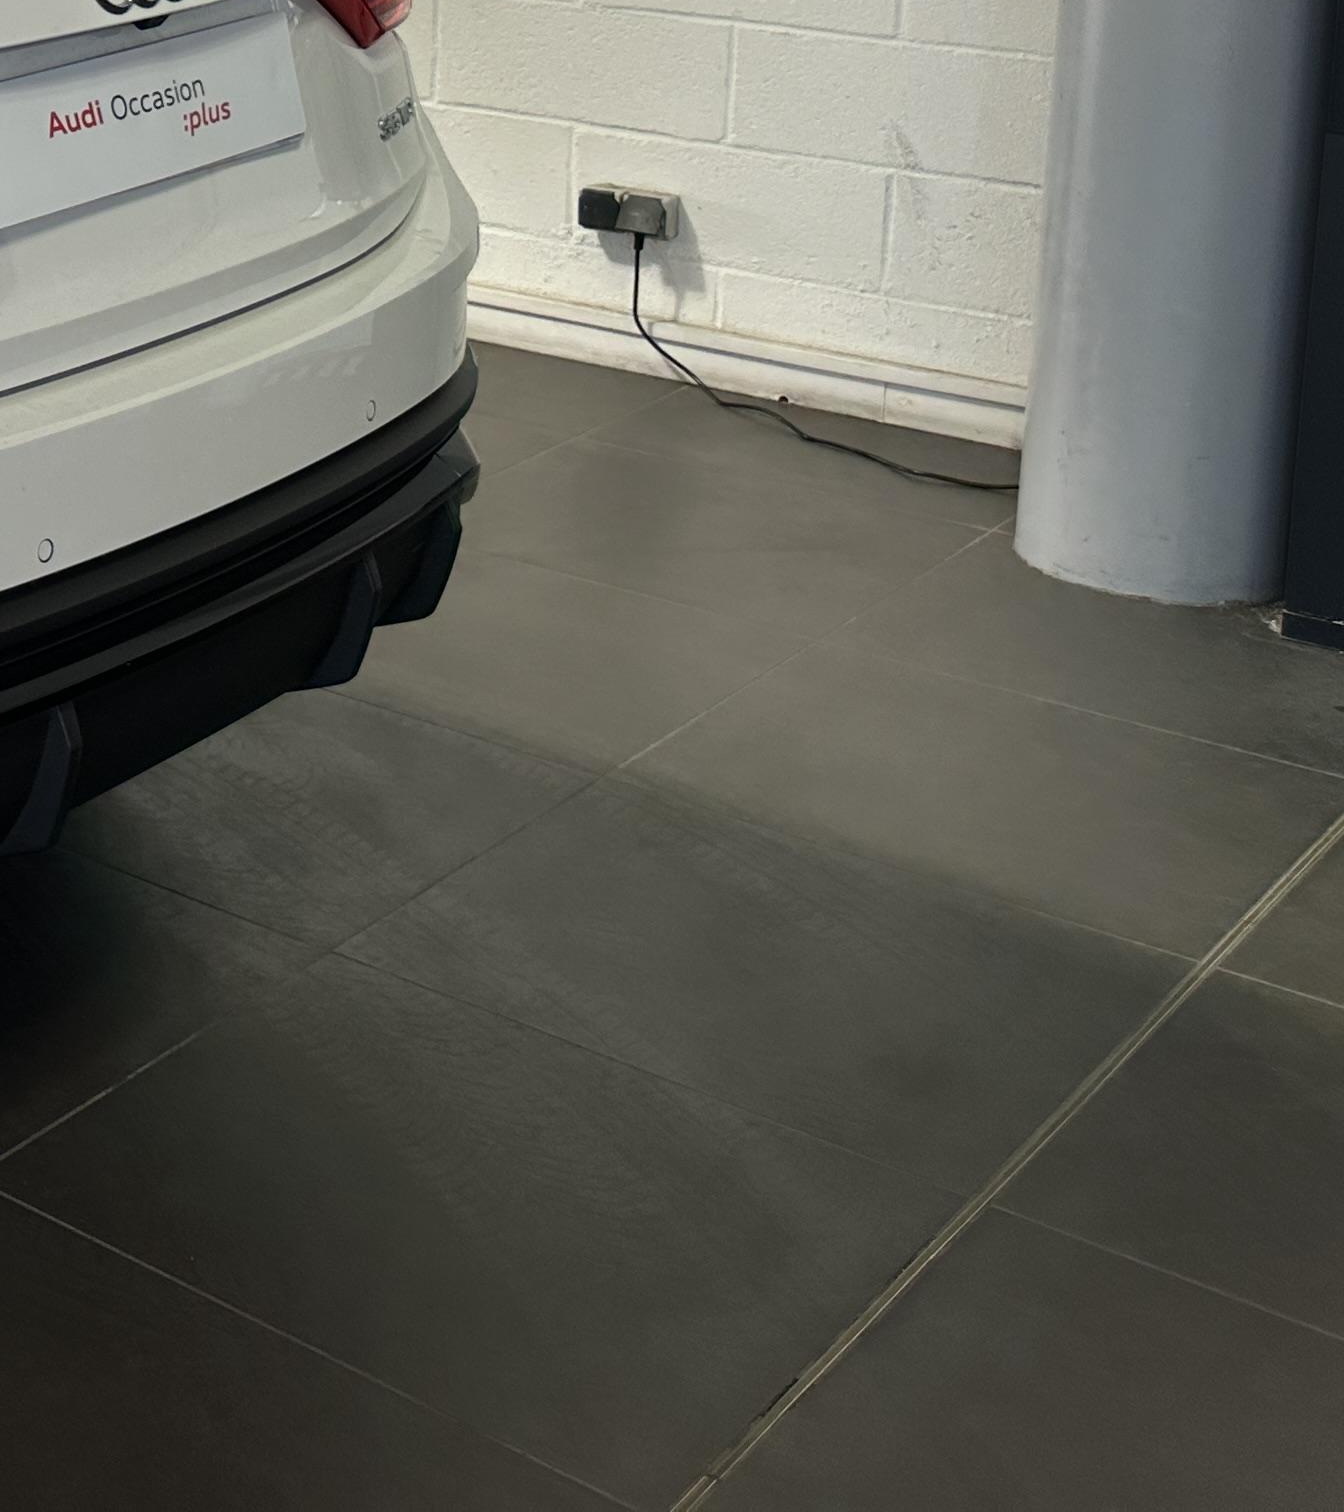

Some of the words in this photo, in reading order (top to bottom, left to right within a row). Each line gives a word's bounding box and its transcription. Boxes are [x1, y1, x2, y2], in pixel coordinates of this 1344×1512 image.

[49, 99, 104, 138] Audi
[110, 79, 205, 120] Occasion
[183, 102, 231, 136] :plus
